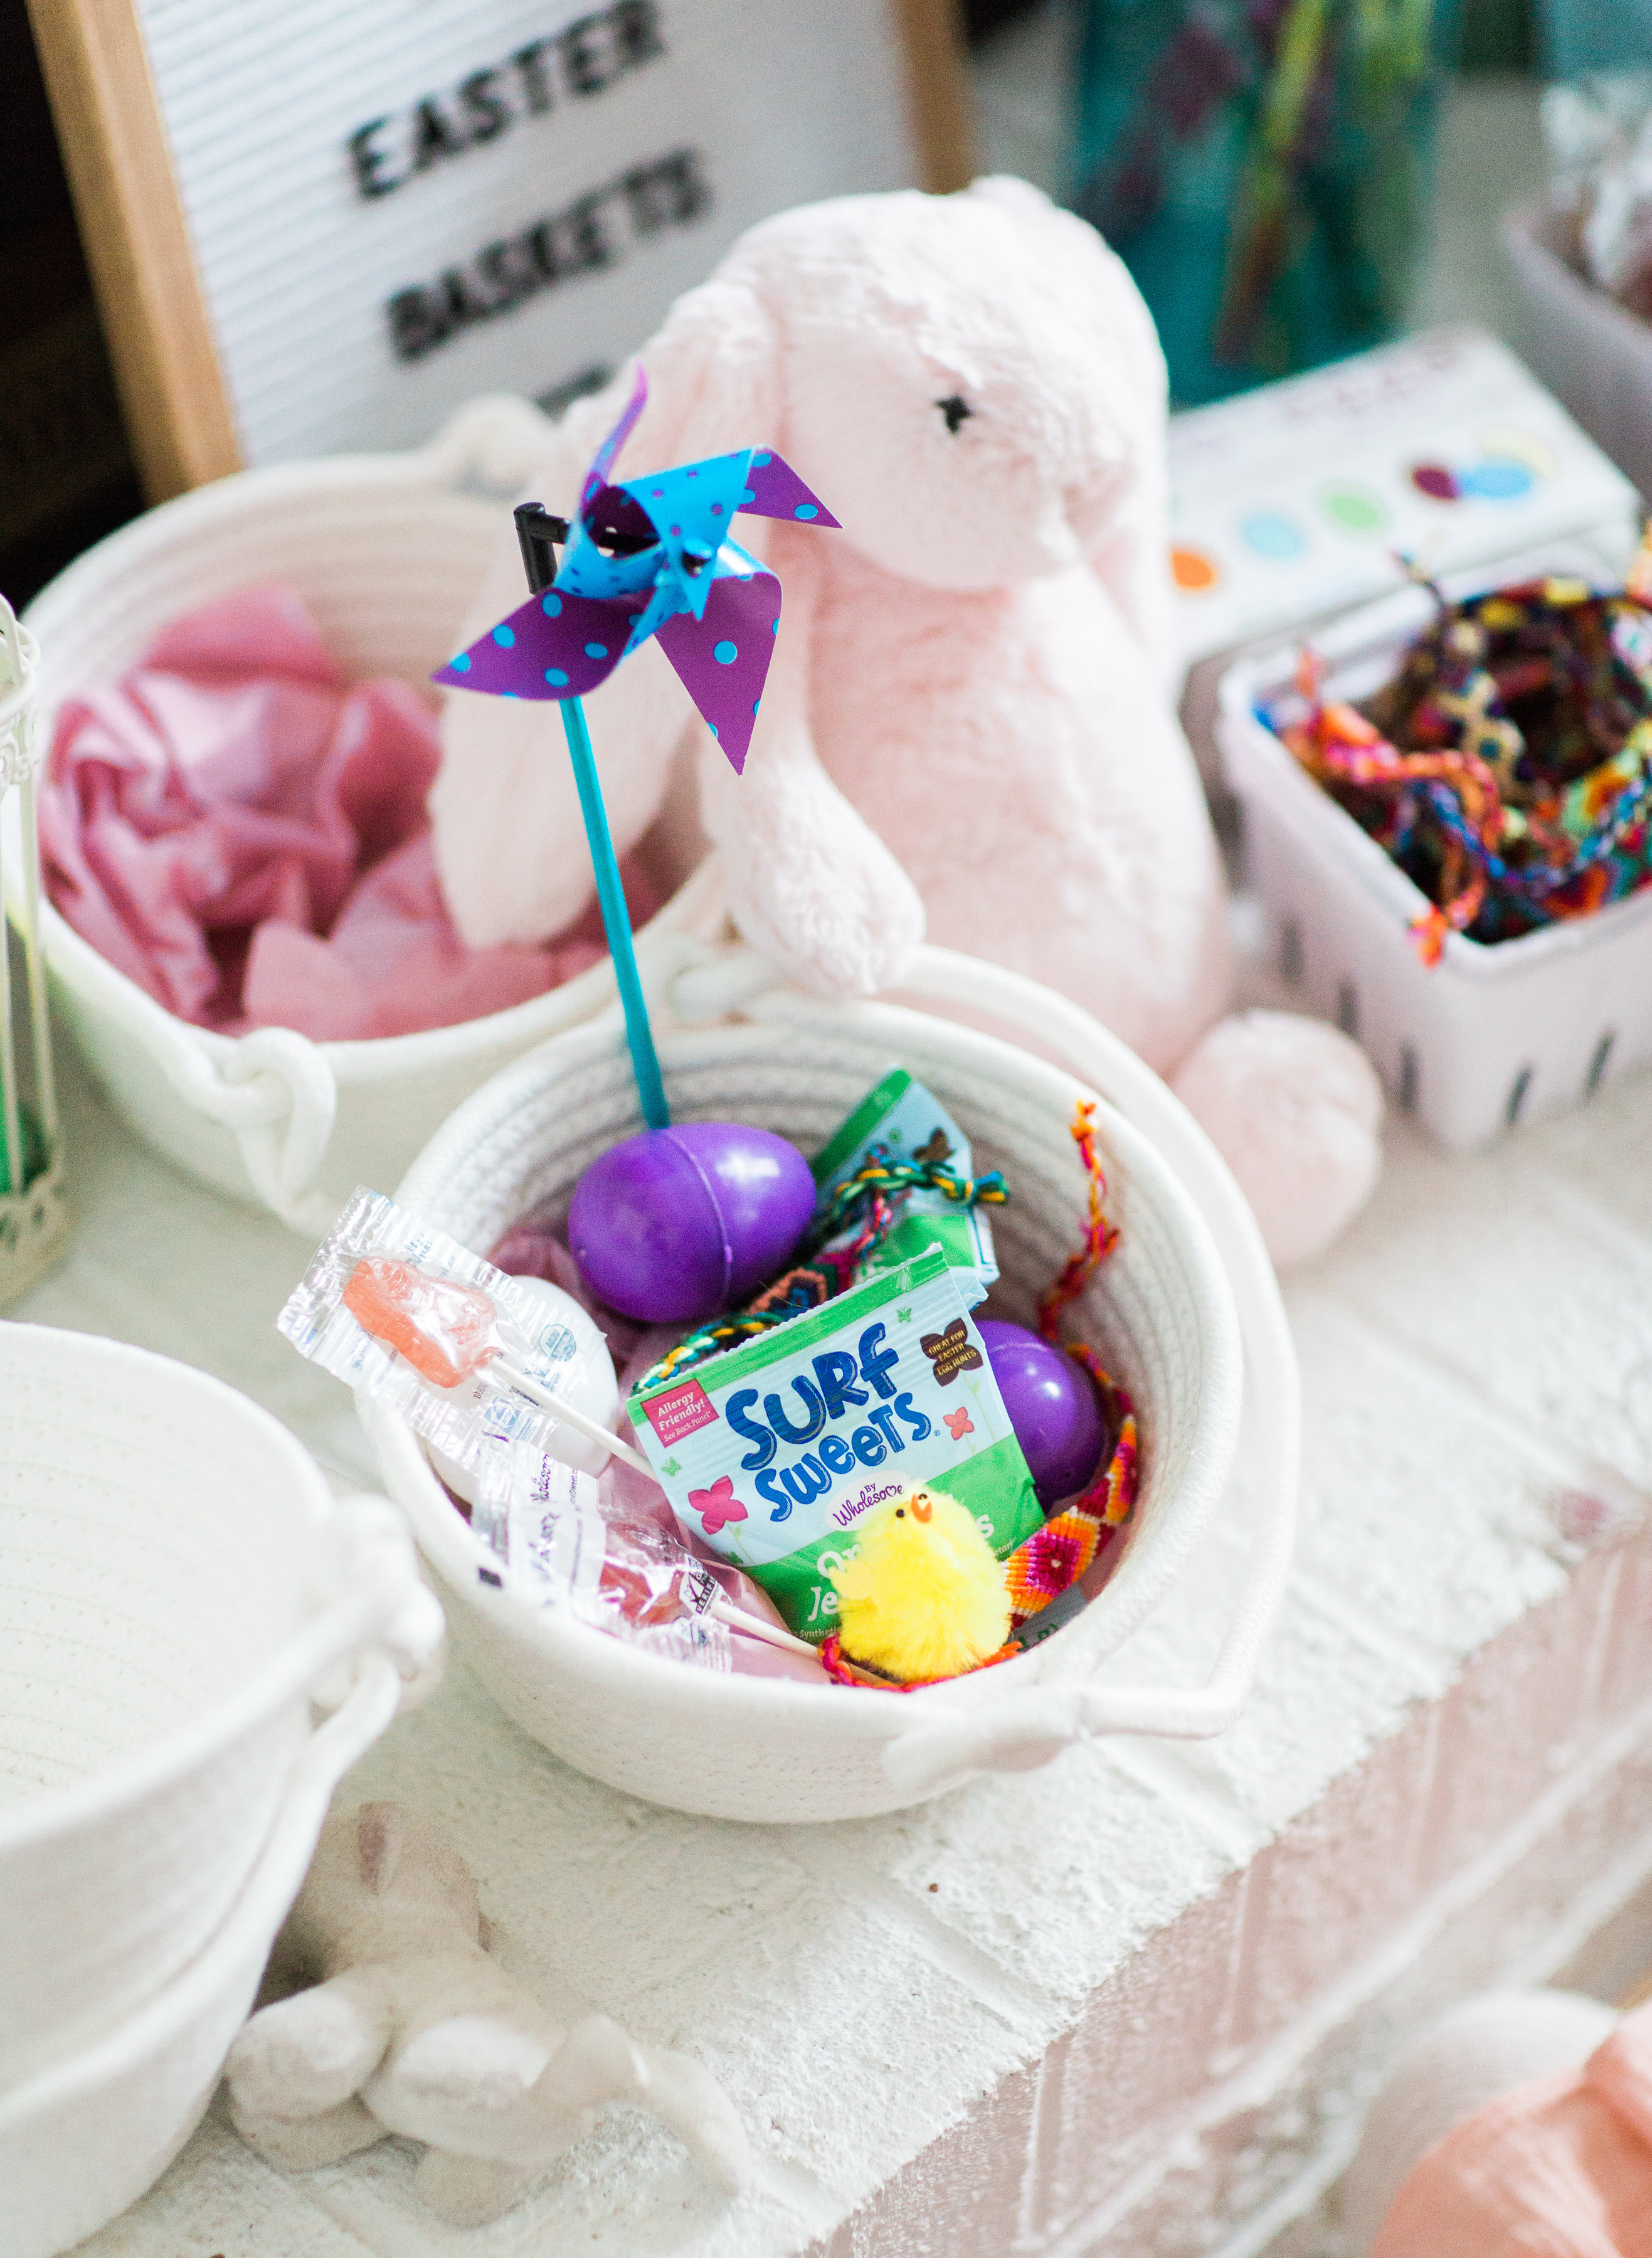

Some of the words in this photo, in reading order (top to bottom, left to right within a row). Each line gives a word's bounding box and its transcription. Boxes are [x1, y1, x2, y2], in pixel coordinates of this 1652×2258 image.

[347, 0, 667, 199] EASTER
[387, 143, 714, 364] BASKETS
[950, 1330, 965, 1342] FOR
[938, 1343, 965, 1362] EASTER
[952, 1349, 977, 1367] HUNTS
[658, 1392, 694, 1417] Allergy
[658, 1398, 705, 1431] Friendly!
[664, 1431, 675, 1442] See
[675, 1422, 691, 1434] Back
[864, 1482, 876, 1493] By
[832, 1484, 903, 1526] Wholesome
